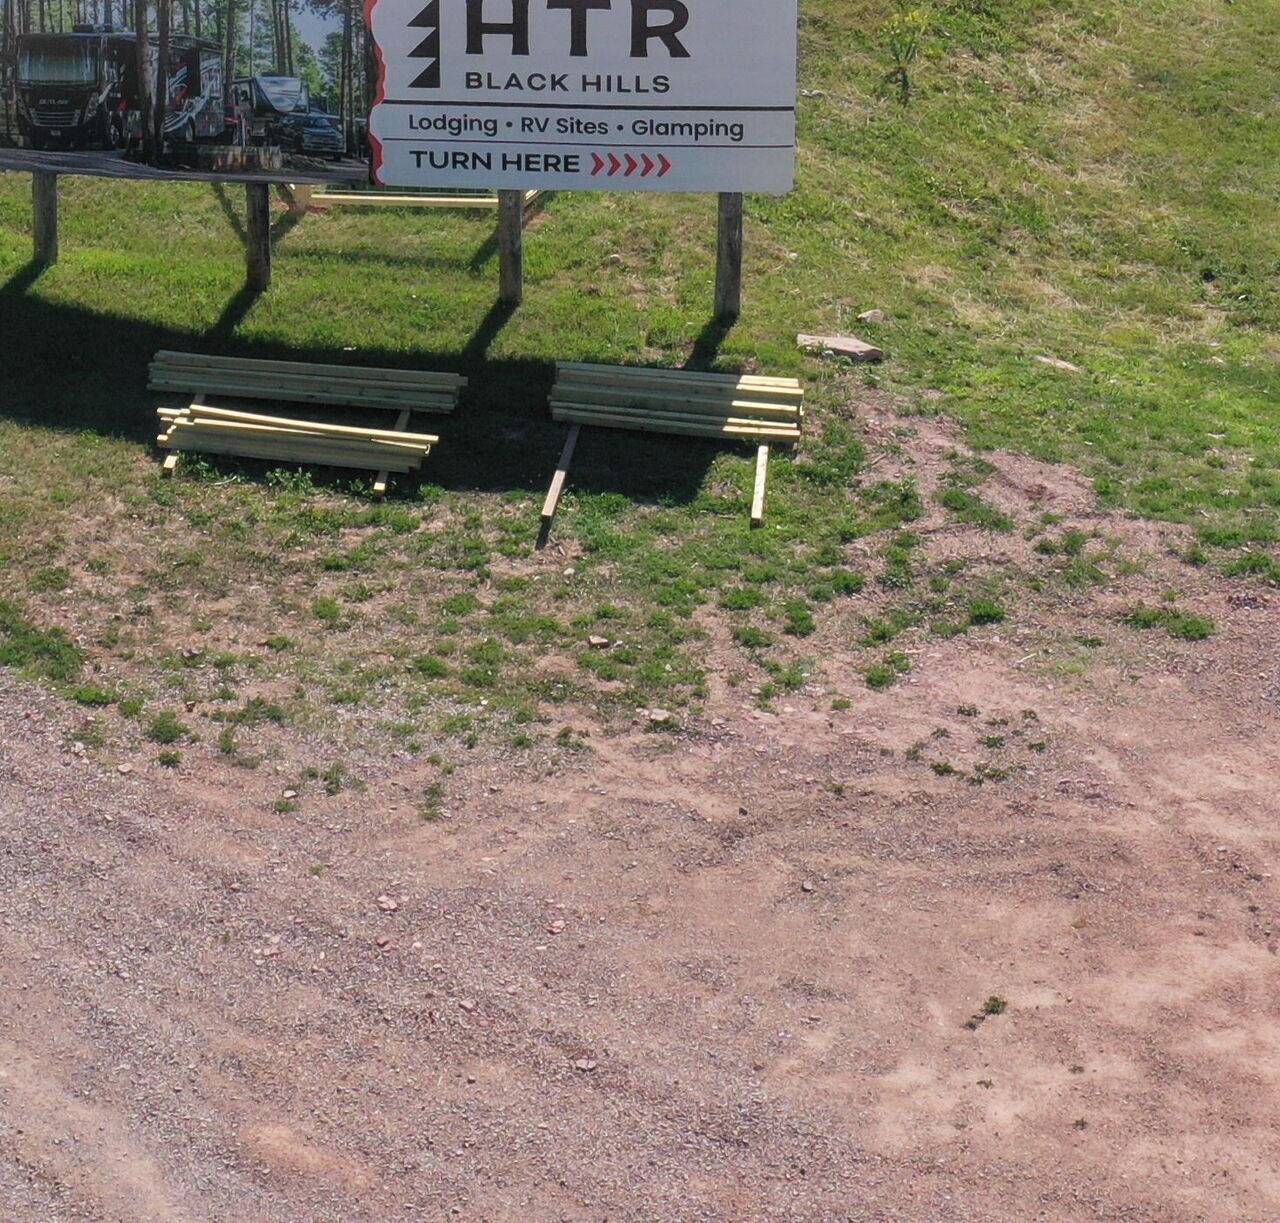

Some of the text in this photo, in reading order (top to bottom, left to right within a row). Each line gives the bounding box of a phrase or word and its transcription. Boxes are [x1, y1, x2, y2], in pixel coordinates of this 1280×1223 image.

[465, 72, 671, 94] BLACK HILLS
[409, 114, 744, 141] Lodging RV Sites Glamping
[410, 150, 581, 173] TURN HERE
